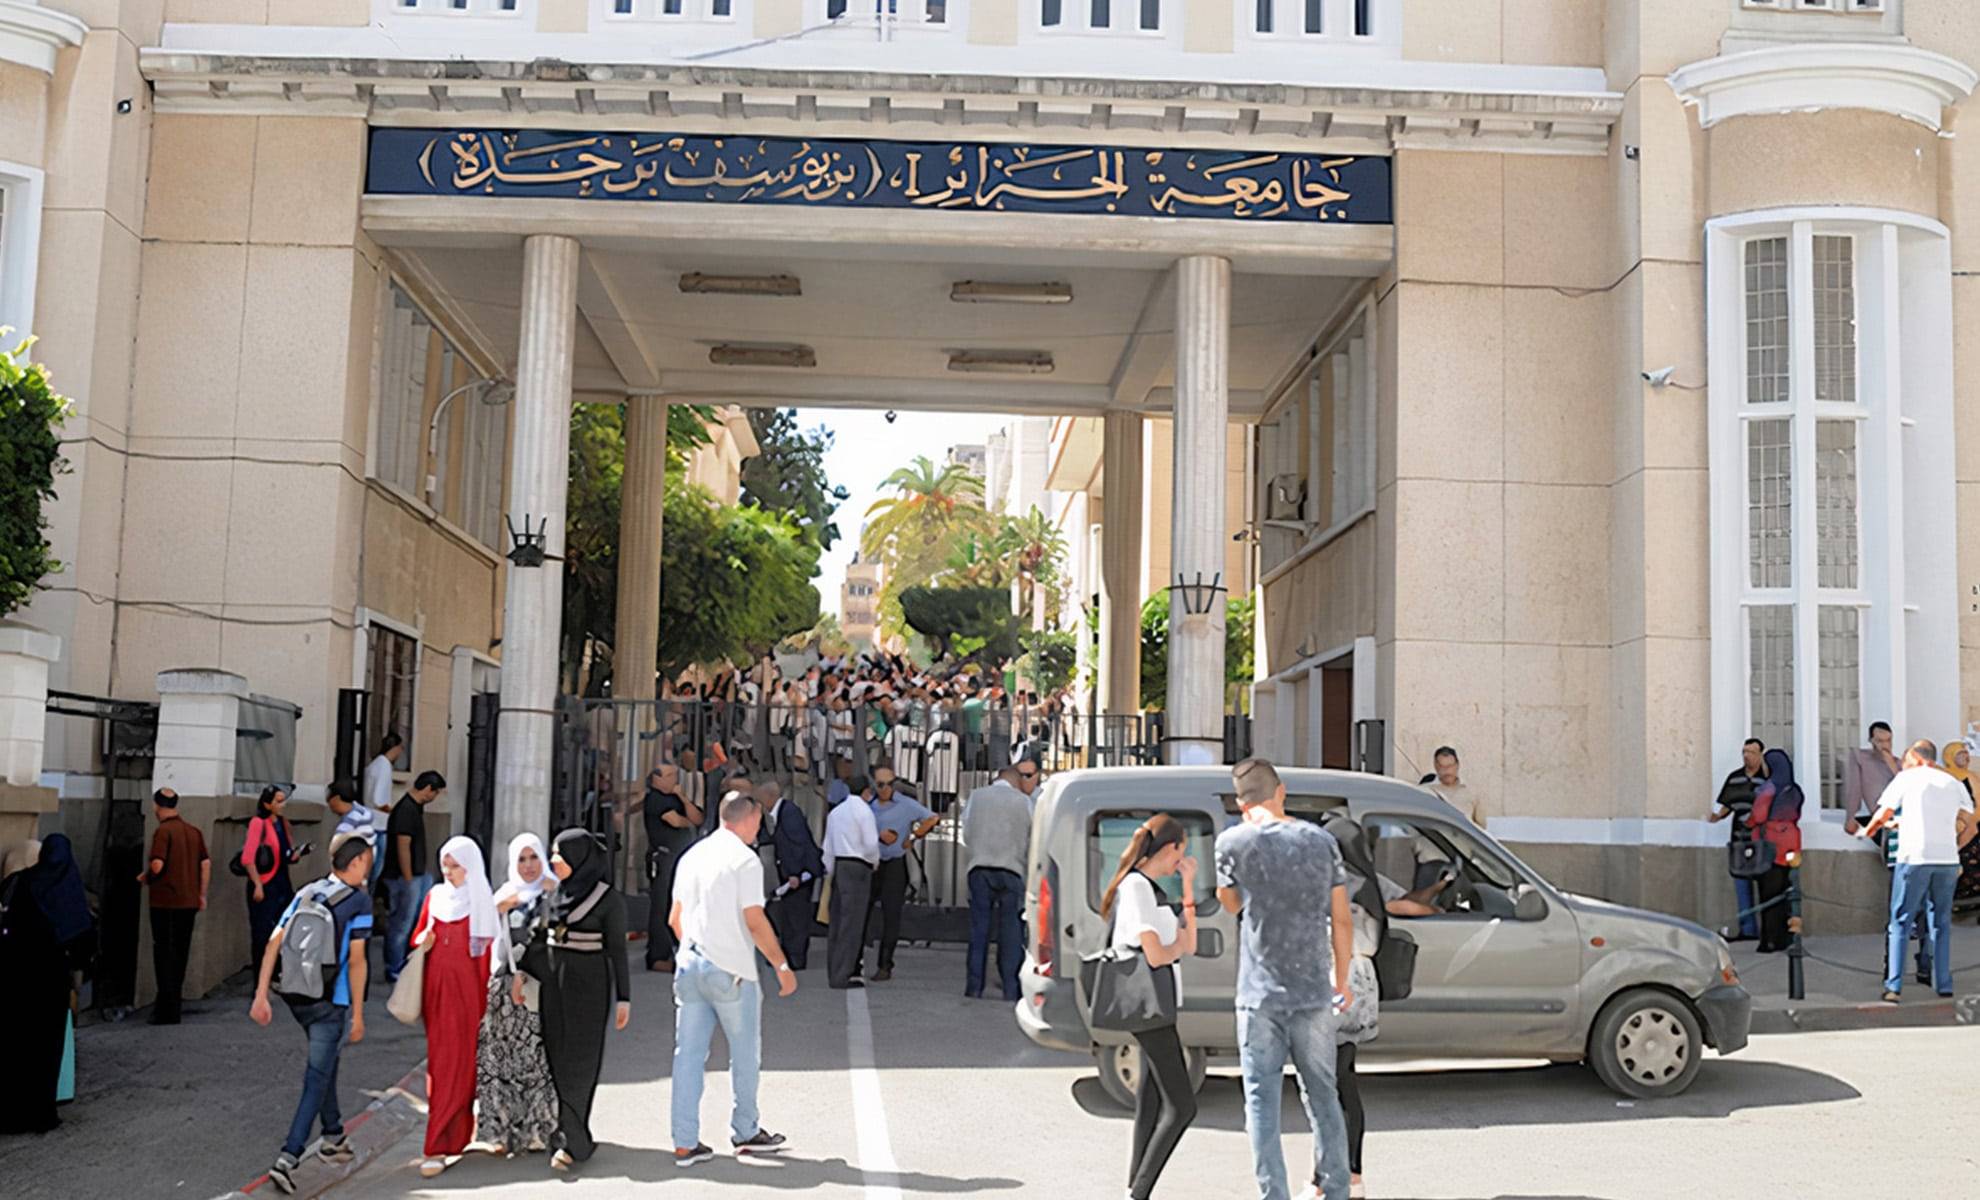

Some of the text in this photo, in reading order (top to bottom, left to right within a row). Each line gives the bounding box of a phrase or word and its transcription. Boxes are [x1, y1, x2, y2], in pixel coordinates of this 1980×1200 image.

[602, 139, 664, 196] بن
[664, 138, 831, 201] يوسف
[911, 143, 1130, 212] الجزائر
[1145, 152, 1355, 220] جامعة
